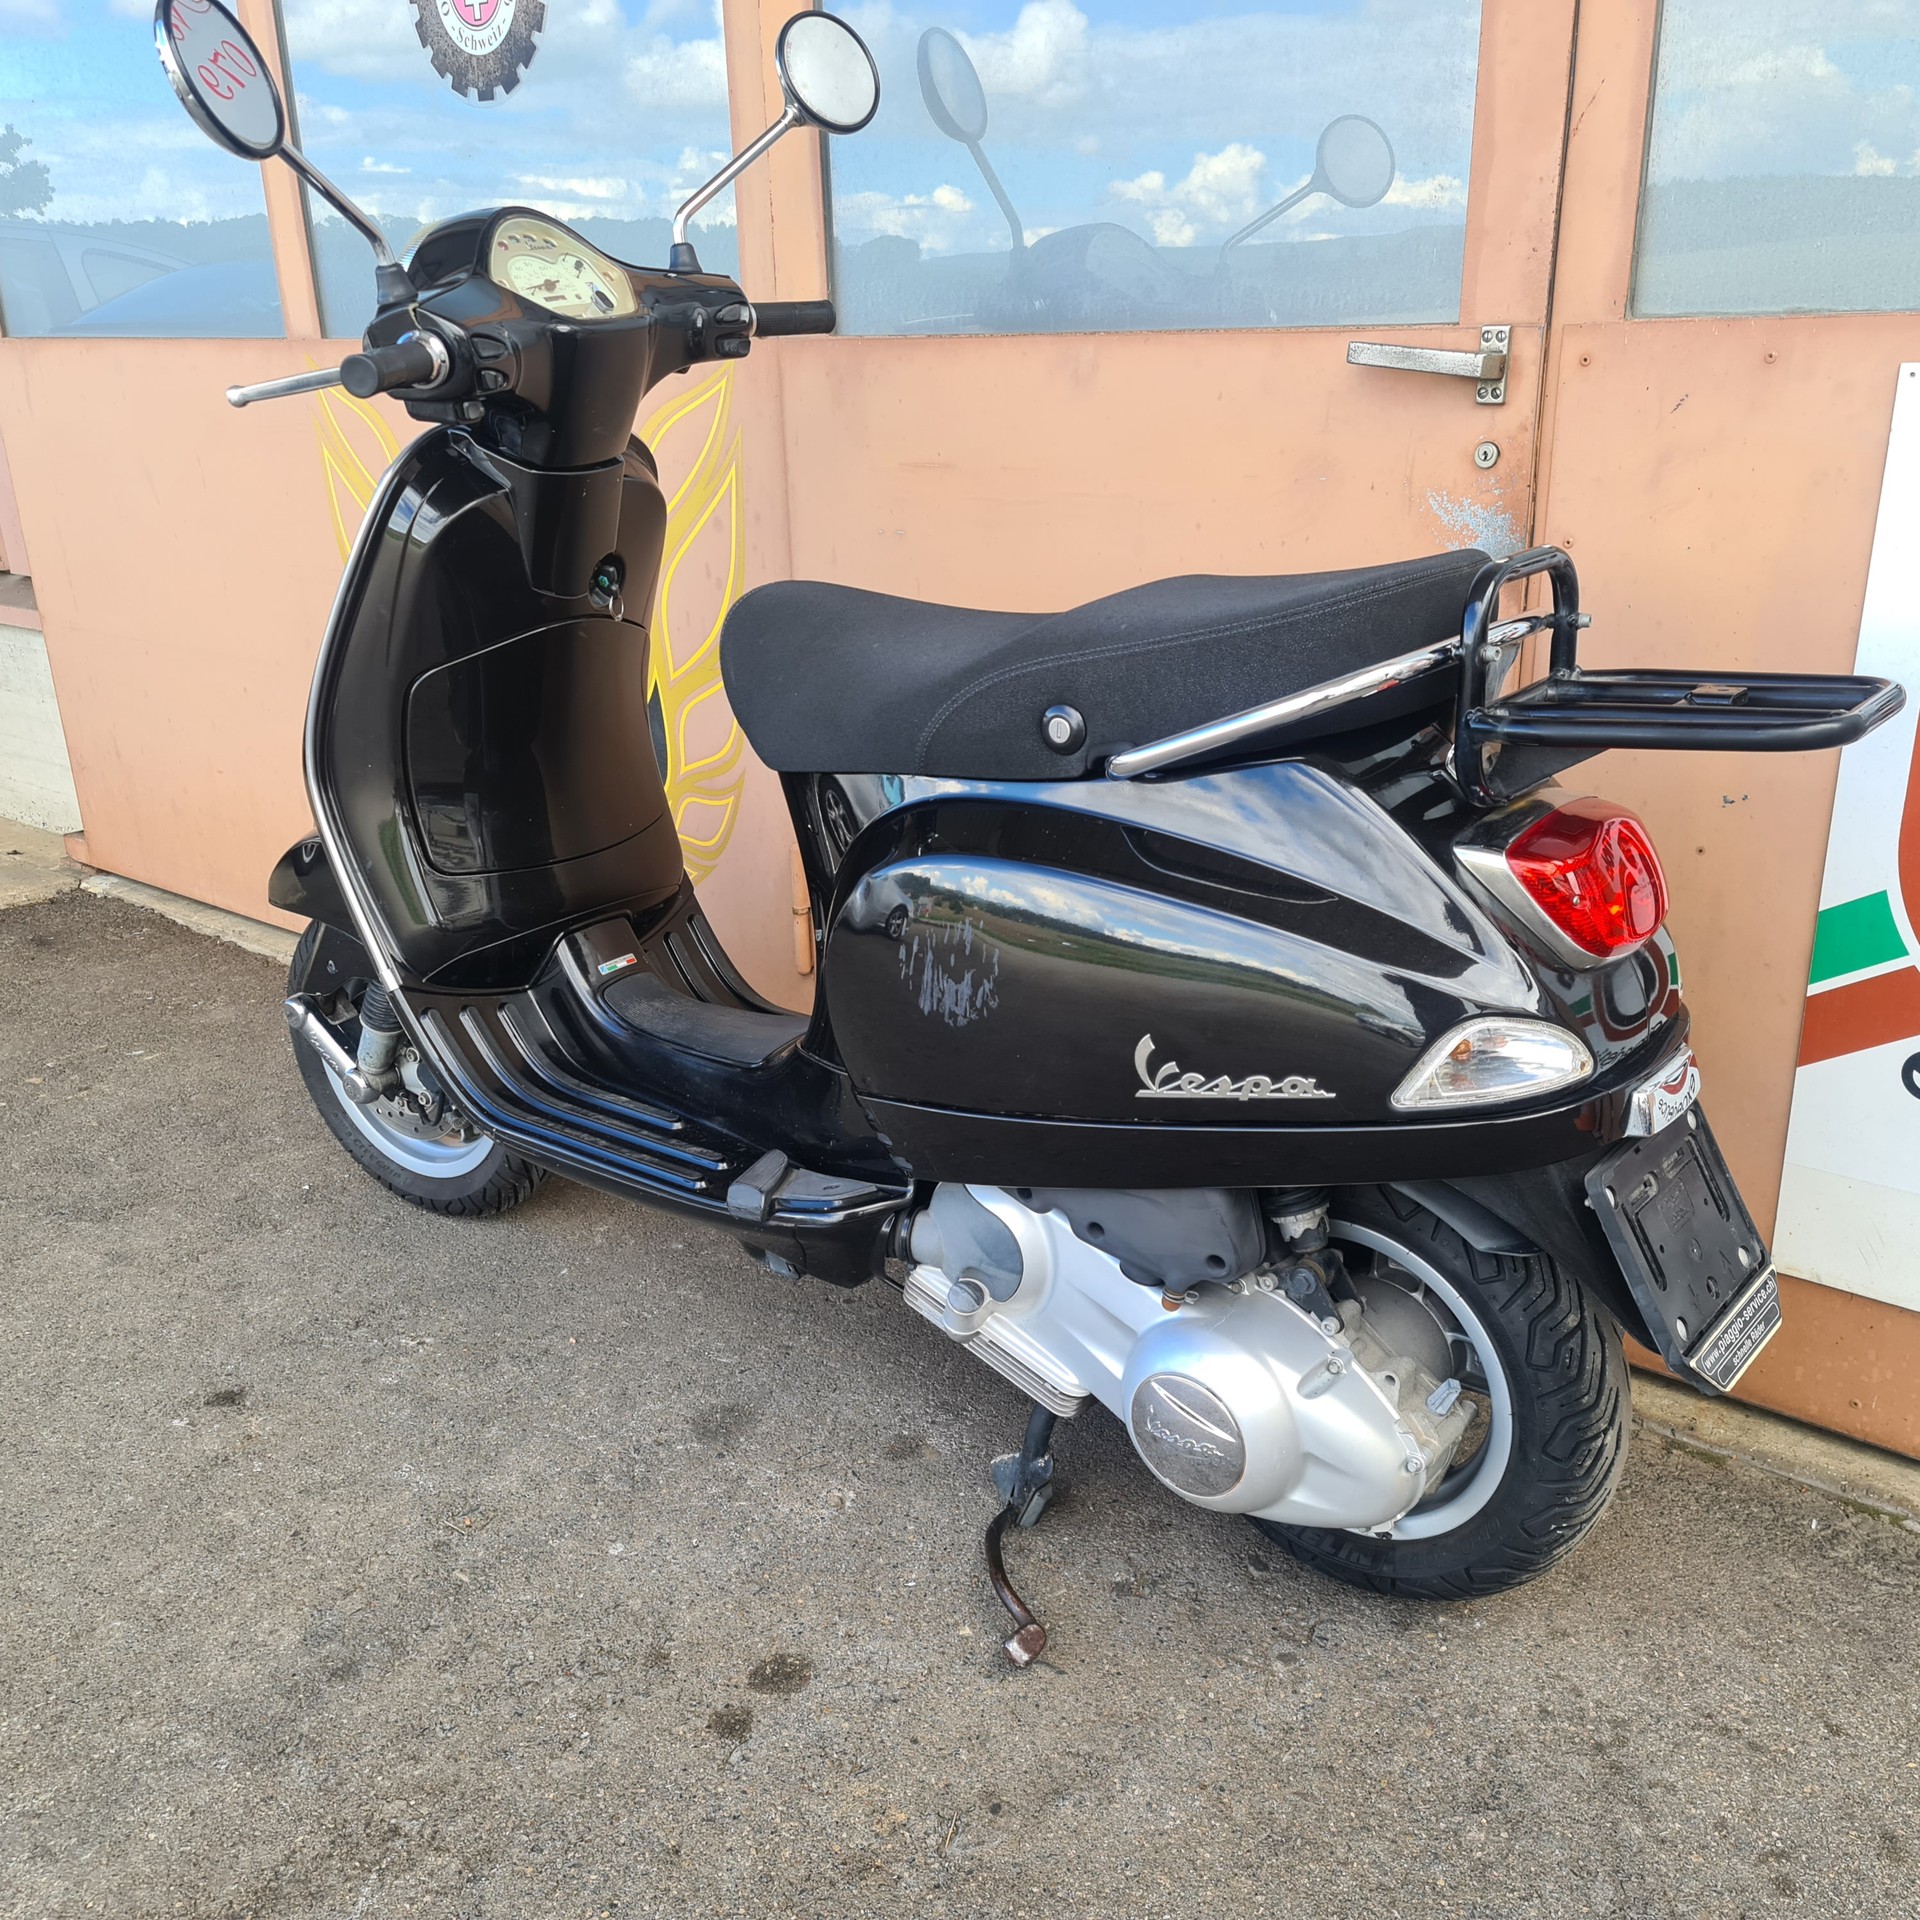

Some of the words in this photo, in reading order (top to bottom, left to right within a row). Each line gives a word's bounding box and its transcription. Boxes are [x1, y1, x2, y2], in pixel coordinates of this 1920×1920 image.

[1134, 1033, 1336, 1102] Vespa
[1704, 1279, 1775, 1369] www.piaggio-service.ch
[1144, 1404, 1225, 1457] Vespa
